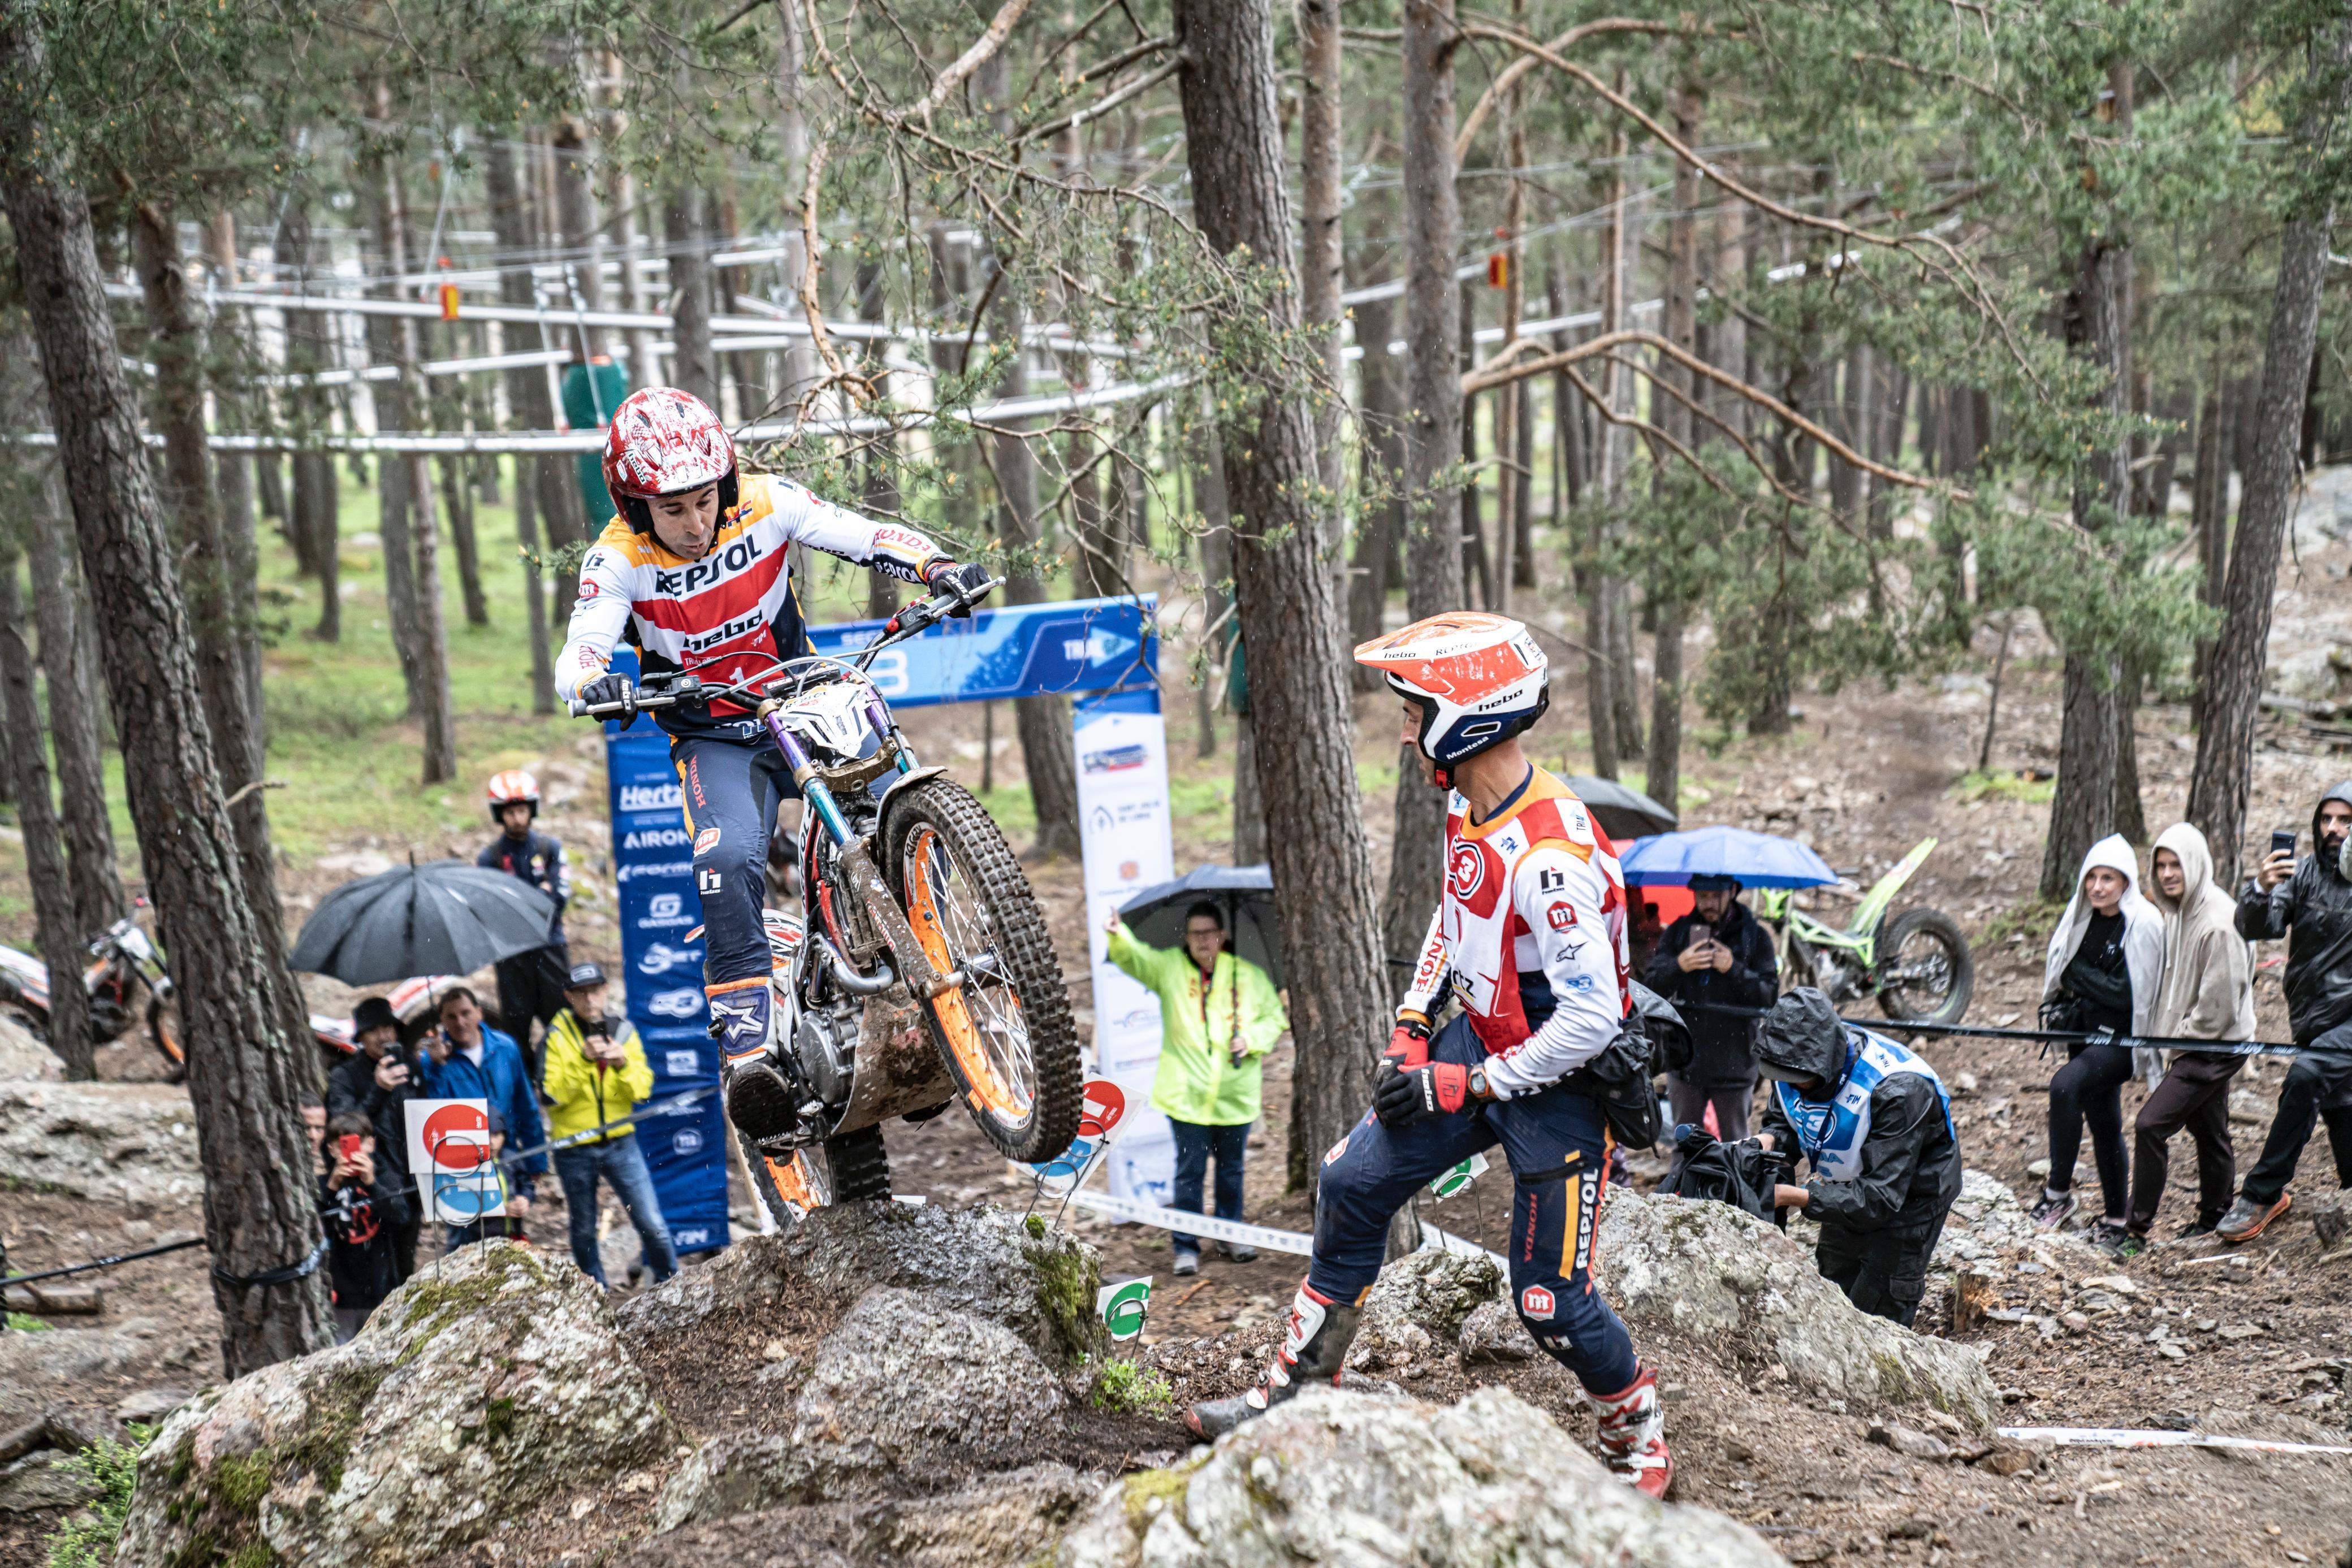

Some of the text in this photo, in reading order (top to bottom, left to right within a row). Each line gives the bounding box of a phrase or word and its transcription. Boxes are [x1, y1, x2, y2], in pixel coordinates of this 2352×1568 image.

[655, 534, 762, 596] REPSOL
[683, 609, 762, 651] hebo
[729, 666, 748, 691] 1
[1478, 689, 1523, 712] hebo
[1446, 735, 1489, 760] Montesa
[690, 754, 707, 809] HONDA
[1458, 855, 1476, 883] 3
[1846, 1094, 1861, 1105] FIM
[1524, 1193, 1538, 1263] HONDA
[1576, 1167, 1599, 1269] REPSOL
